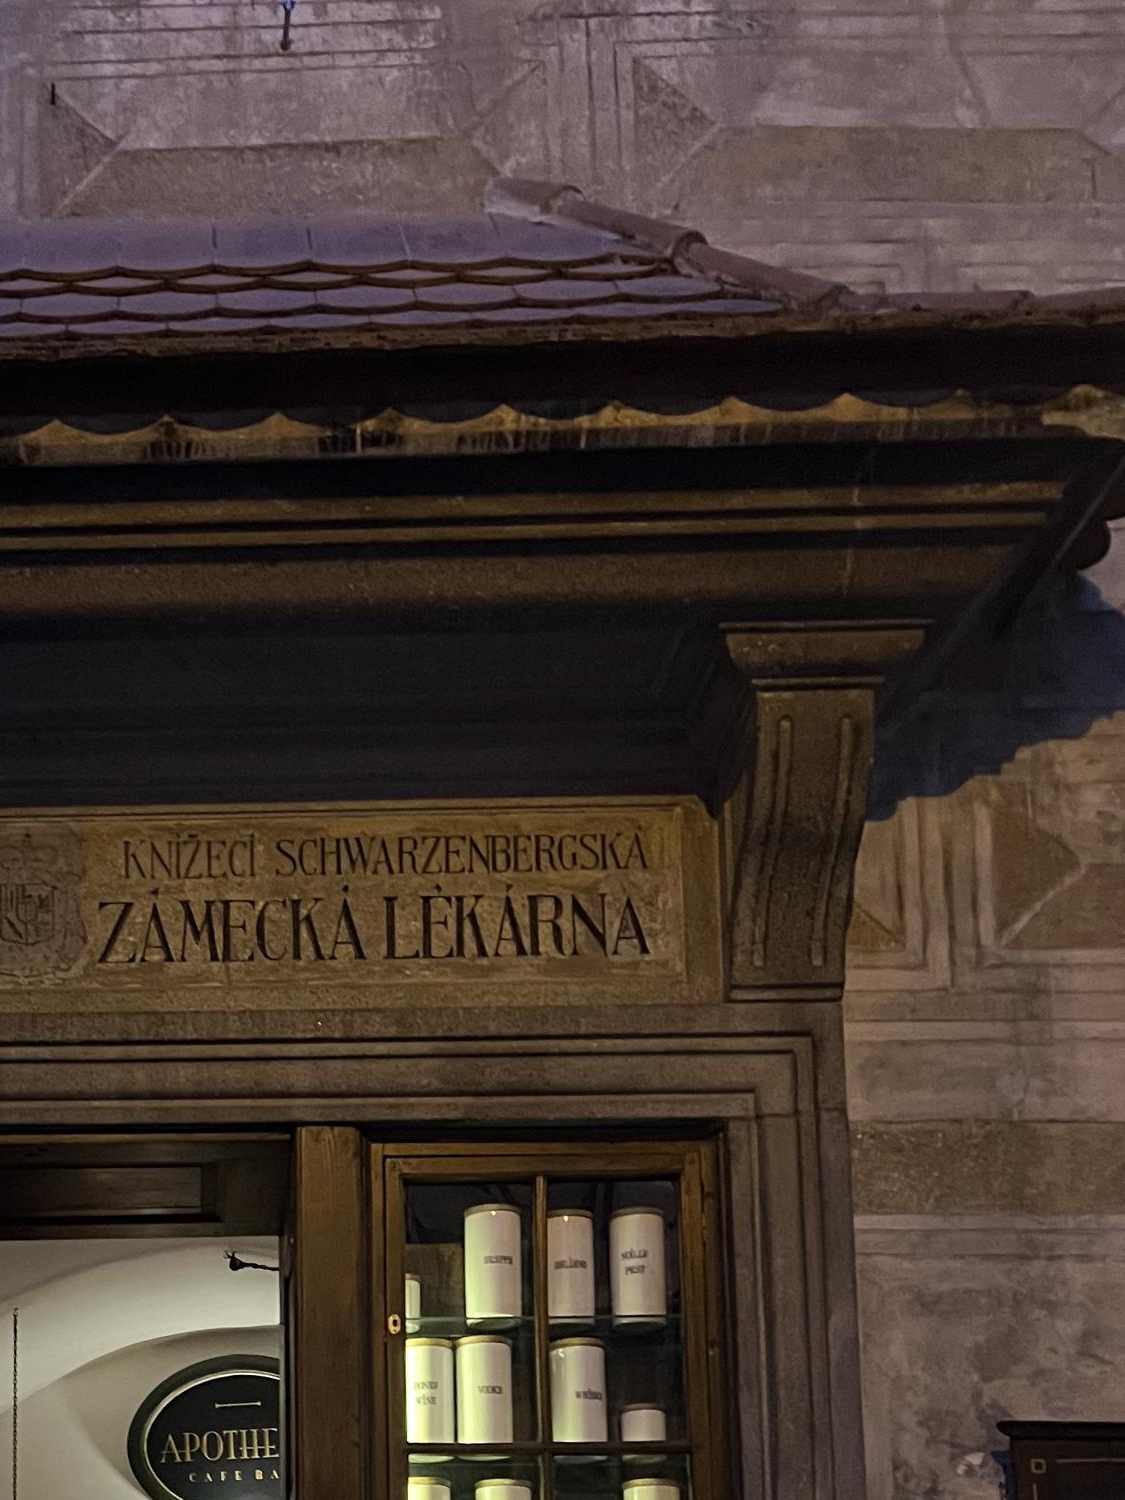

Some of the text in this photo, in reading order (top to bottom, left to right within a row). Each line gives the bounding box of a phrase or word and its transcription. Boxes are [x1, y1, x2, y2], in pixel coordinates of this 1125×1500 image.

[97, 883, 651, 963] ZÁMECKÁ LÉKÁRNA
[160, 1427, 280, 1464] APOTHE
[189, 1469, 280, 1483] CAFE BA
